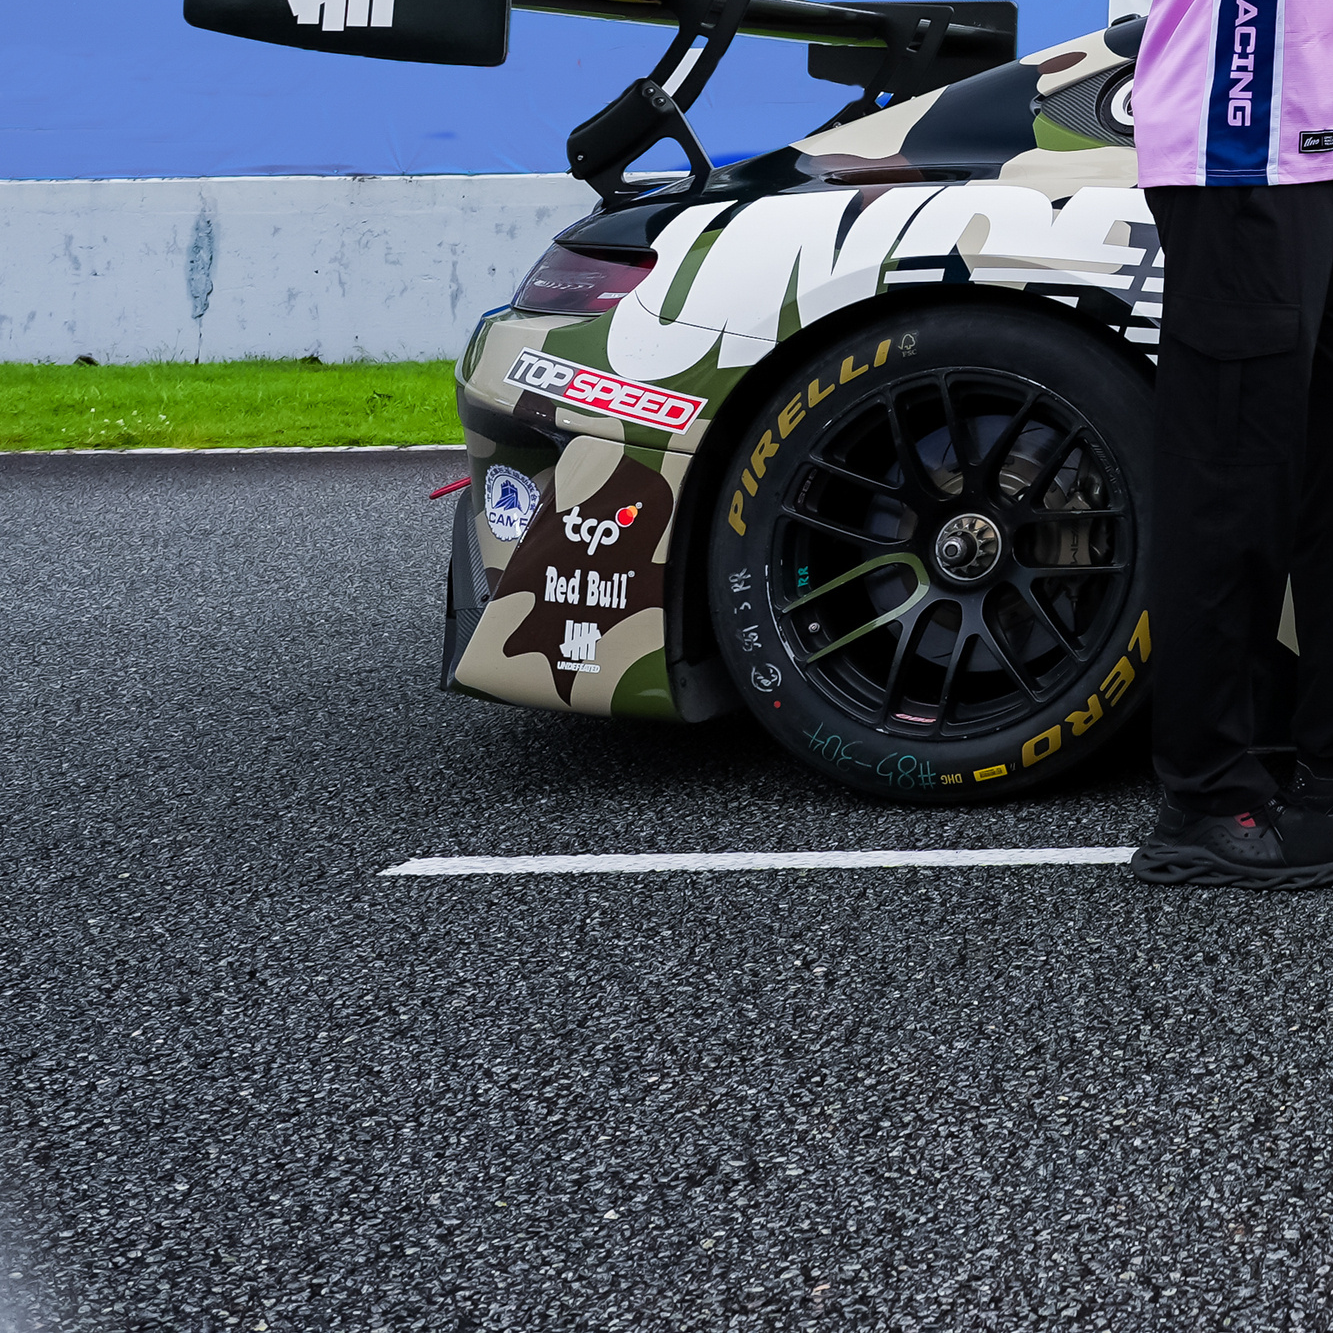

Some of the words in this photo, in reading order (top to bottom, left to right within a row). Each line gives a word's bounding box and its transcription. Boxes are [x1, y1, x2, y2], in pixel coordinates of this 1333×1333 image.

[728, 338, 892, 537] PIRELLI
[544, 566, 582, 605] Red
[586, 570, 628, 609] Bull
[1021, 609, 1152, 768] ZERO
